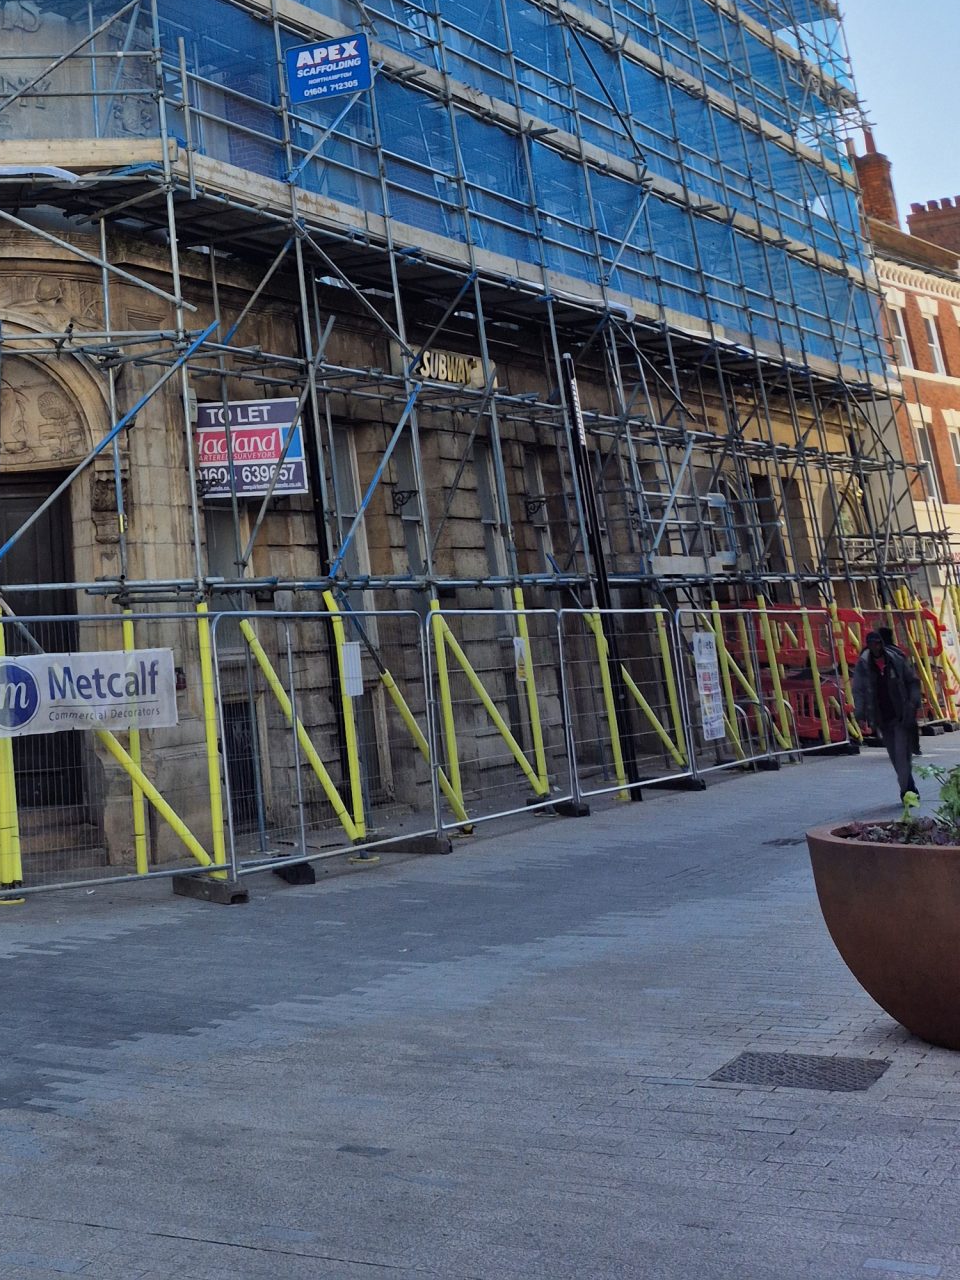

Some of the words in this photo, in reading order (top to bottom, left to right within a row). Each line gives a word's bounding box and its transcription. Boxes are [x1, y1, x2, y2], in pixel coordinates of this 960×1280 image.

[296, 40, 359, 67] APEX
[297, 57, 361, 78] SCAFFOLDING
[304, 86, 327, 97] 01604
[330, 80, 358, 91] 712305
[420, 350, 477, 385] SUBWAY
[206, 408, 232, 424] TO
[237, 406, 271, 422] LET
[234, 451, 276, 460] SURVEYORS
[48, 660, 159, 700] Metcalf
[48, 710, 107, 722] Commercial
[110, 707, 160, 719] Decorators
